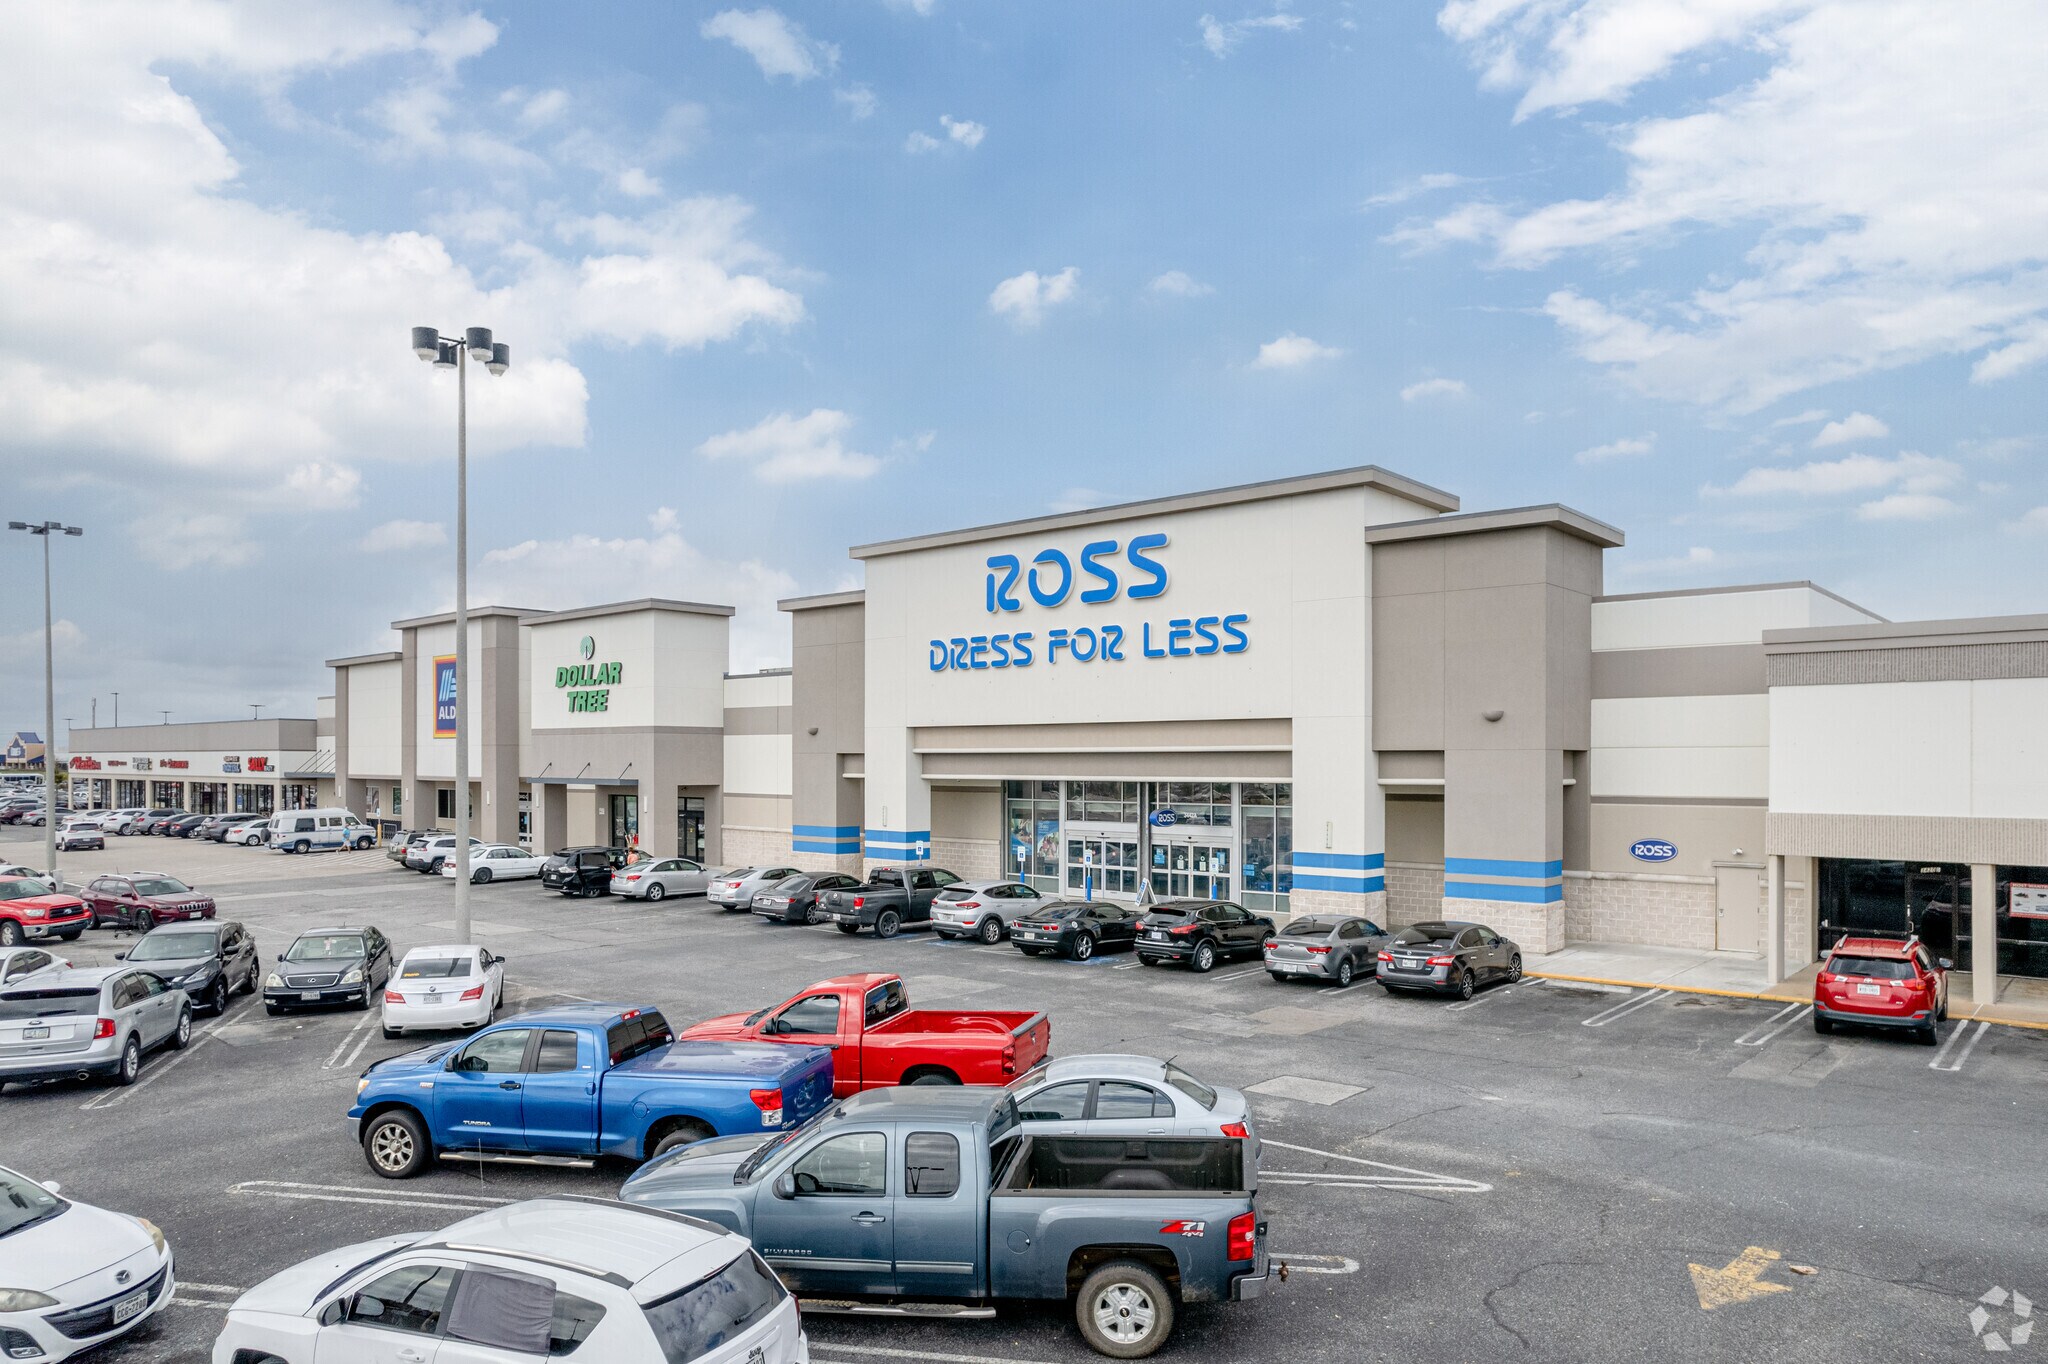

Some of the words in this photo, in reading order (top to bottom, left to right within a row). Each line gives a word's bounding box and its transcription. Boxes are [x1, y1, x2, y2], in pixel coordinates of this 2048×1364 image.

[986, 533, 1171, 613] ROSS
[930, 632, 1034, 672] DRESS
[1048, 625, 1125, 664] FOR
[1143, 614, 1250, 658] LESS
[555, 661, 623, 689] DOLLAR
[567, 689, 610, 712] TREE
[438, 705, 457, 720] ALD
[1158, 813, 1176, 823] ROSS
[1635, 844, 1673, 857] ROSS
[1159, 1219, 1206, 1233] Z71
[763, 1248, 812, 1256] SILVERADO
